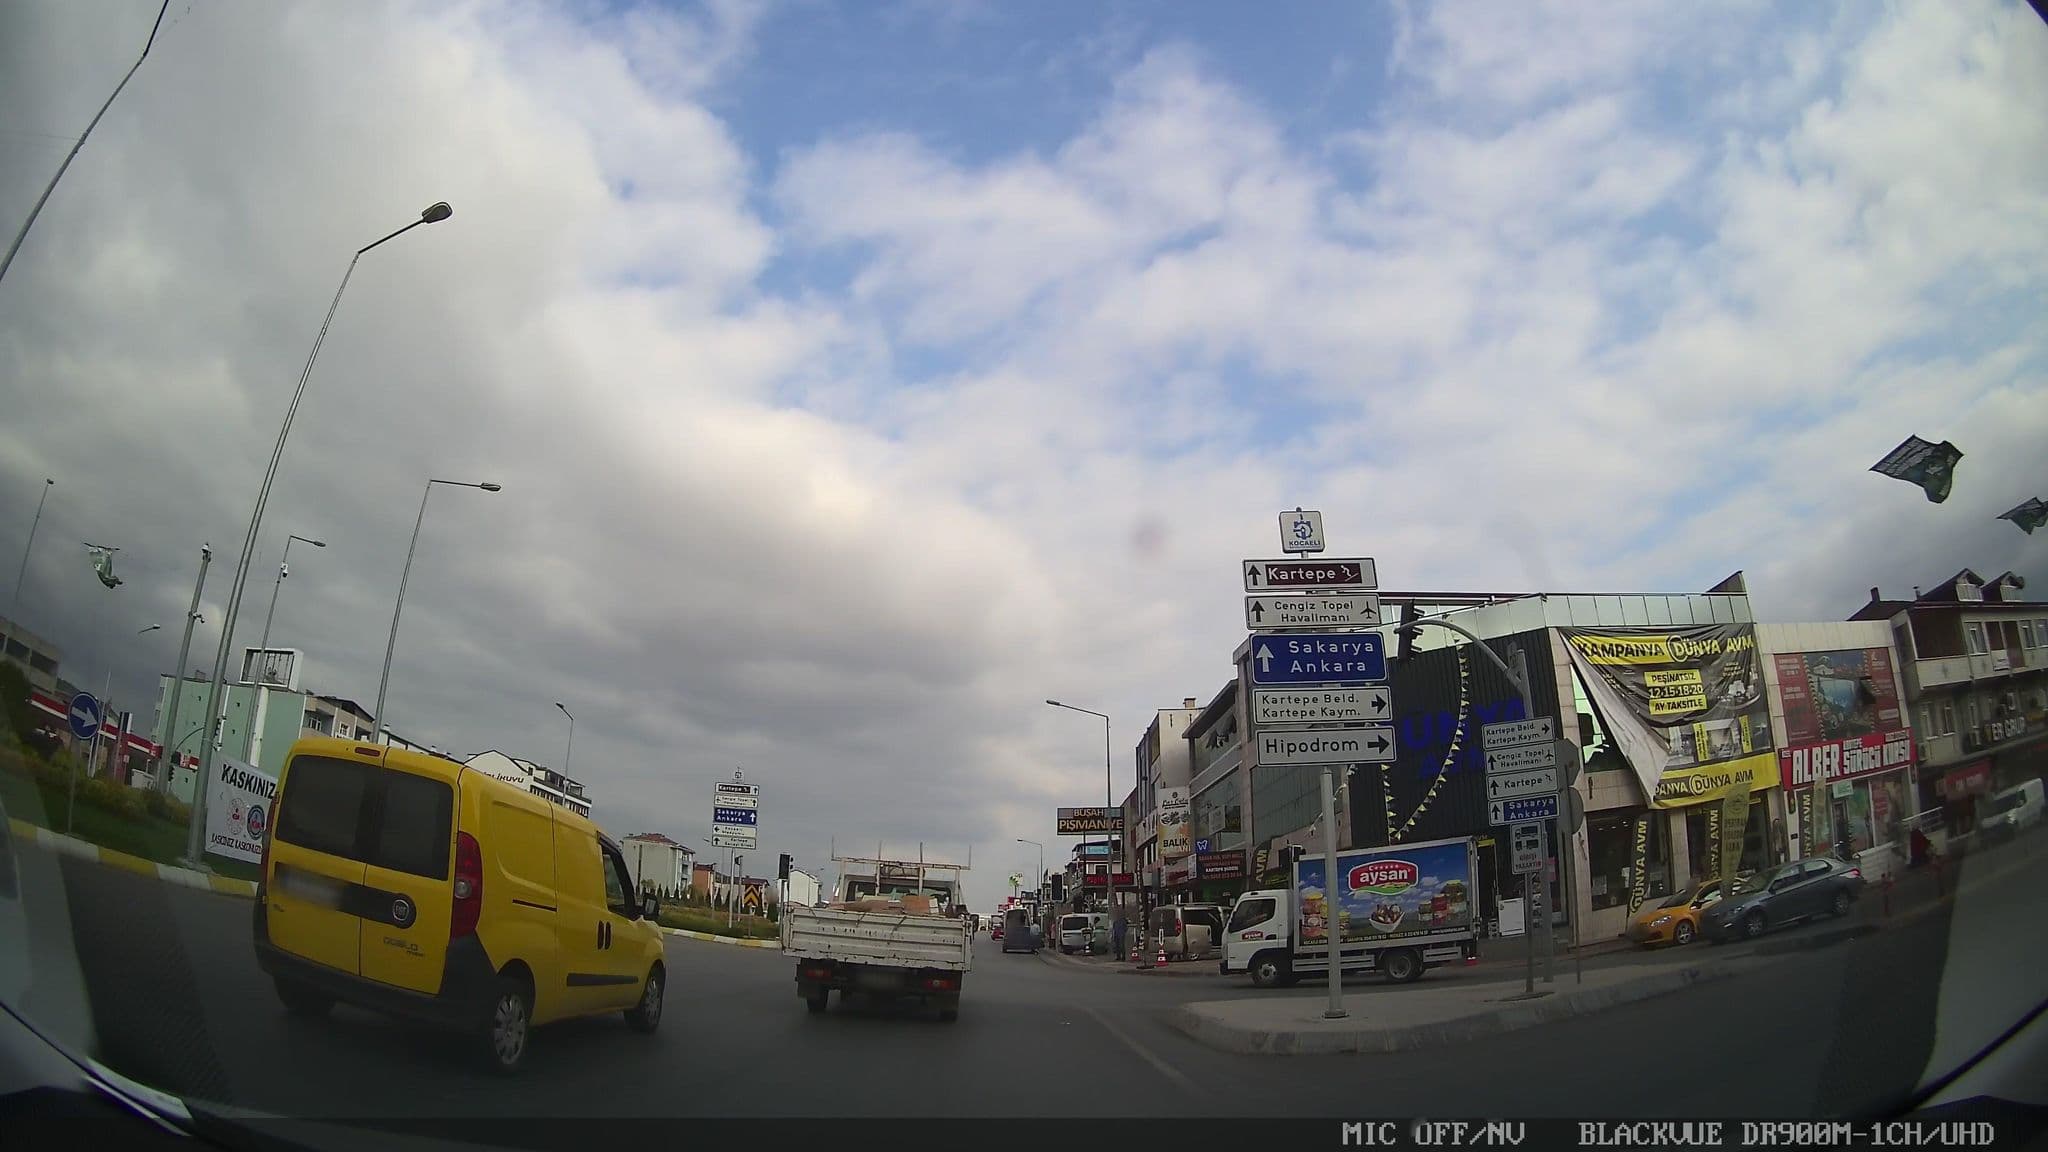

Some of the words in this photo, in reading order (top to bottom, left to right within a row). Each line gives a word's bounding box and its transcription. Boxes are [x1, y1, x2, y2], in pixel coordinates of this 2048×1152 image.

[1268, 566, 1336, 583] Kartepe
[1274, 600, 1316, 611] Cengiz
[1321, 600, 1353, 610] Topel
[1288, 640, 1374, 655] Sakarya
[1578, 642, 1664, 658] KAMPANYA
[1672, 638, 1720, 656] DÜNYA
[1726, 634, 1754, 652] AVM
[1290, 660, 1366, 673] Ankara
[1262, 694, 1319, 707] Kartepe
[1324, 694, 1359, 704] Beld.
[1654, 701, 1666, 712] AY
[1666, 698, 1704, 711] TAKSİTLE
[1262, 707, 1316, 720] Kartepe
[1320, 706, 1361, 719] Kaym.
[1486, 726, 1515, 736] Kartepe
[1266, 738, 1359, 757] Hipodrom
[1487, 736, 1516, 746] Kartepe
[1793, 744, 1840, 784] ALBER
[221, 764, 276, 800] KASKINIZ
[1504, 778, 1542, 790] Kartepe
[1695, 774, 1731, 790] DÜNYA
[1734, 770, 1754, 784] AVM
[1508, 799, 1554, 810] Sakarya
[1802, 794, 1810, 822] AVM
[1510, 810, 1550, 820] Ankara
[1710, 810, 1718, 839] AVM
[1636, 820, 1647, 854] AVM
[1360, 869, 1408, 886] aysan
[1632, 856, 1646, 906] DÜNYA
